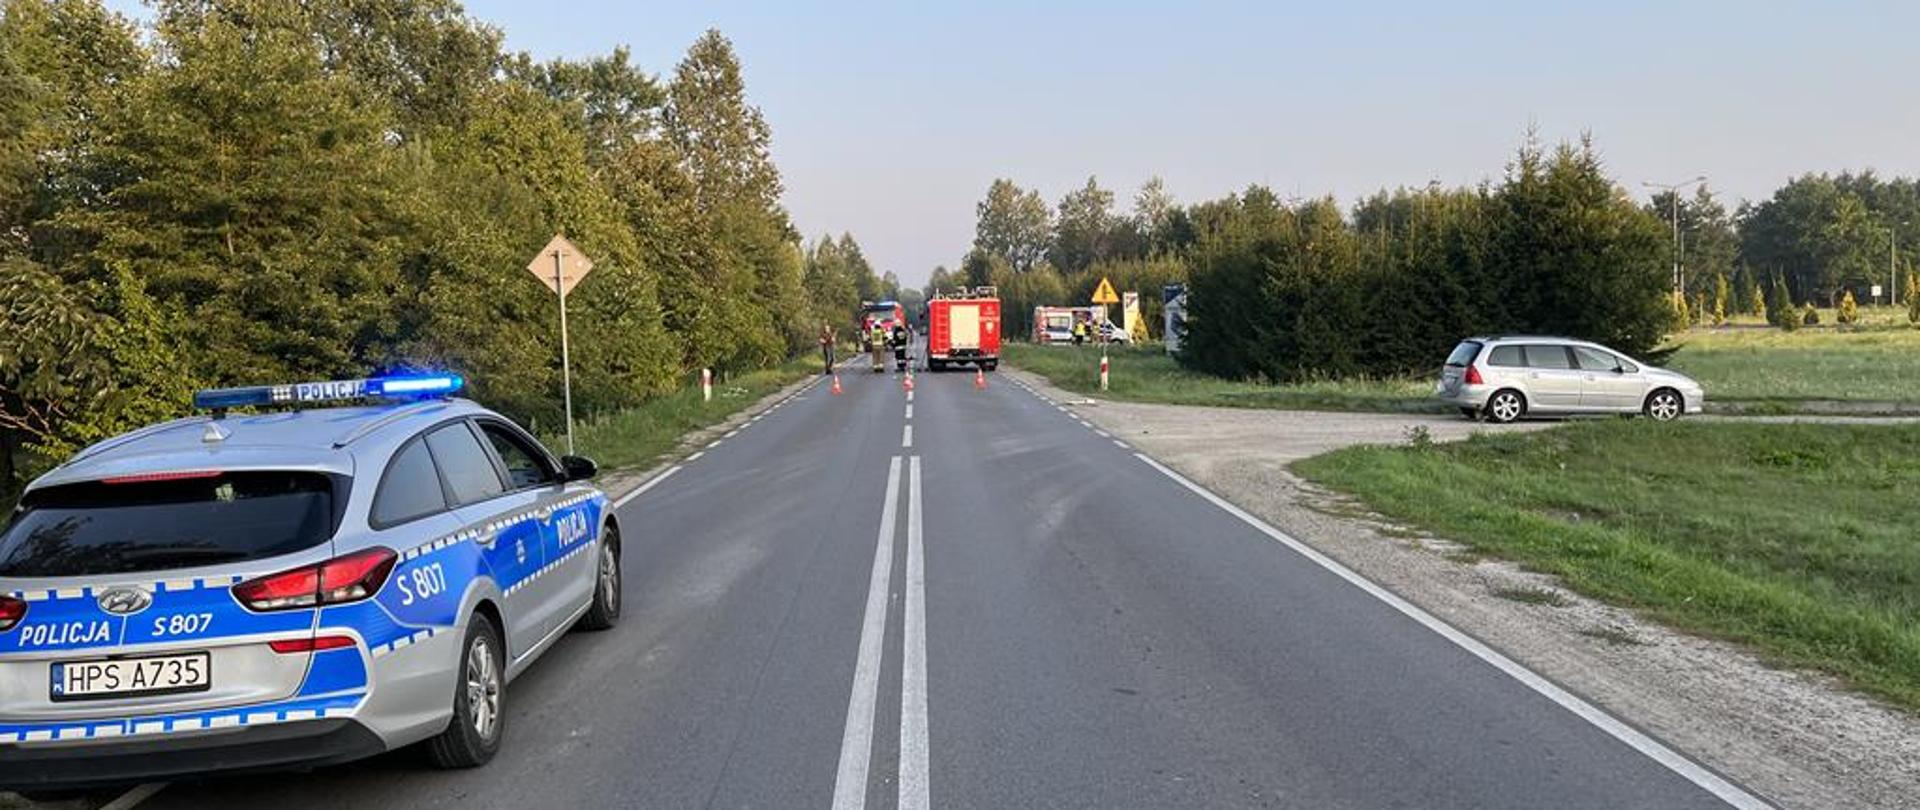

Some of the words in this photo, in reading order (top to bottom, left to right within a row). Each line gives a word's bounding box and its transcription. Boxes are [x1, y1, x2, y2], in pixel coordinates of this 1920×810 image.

[397, 575, 414, 605] S
[413, 563, 446, 599] 807
[18, 621, 110, 647] POLICJA
[68, 664, 120, 692] HPS
[131, 659, 200, 688] A735
